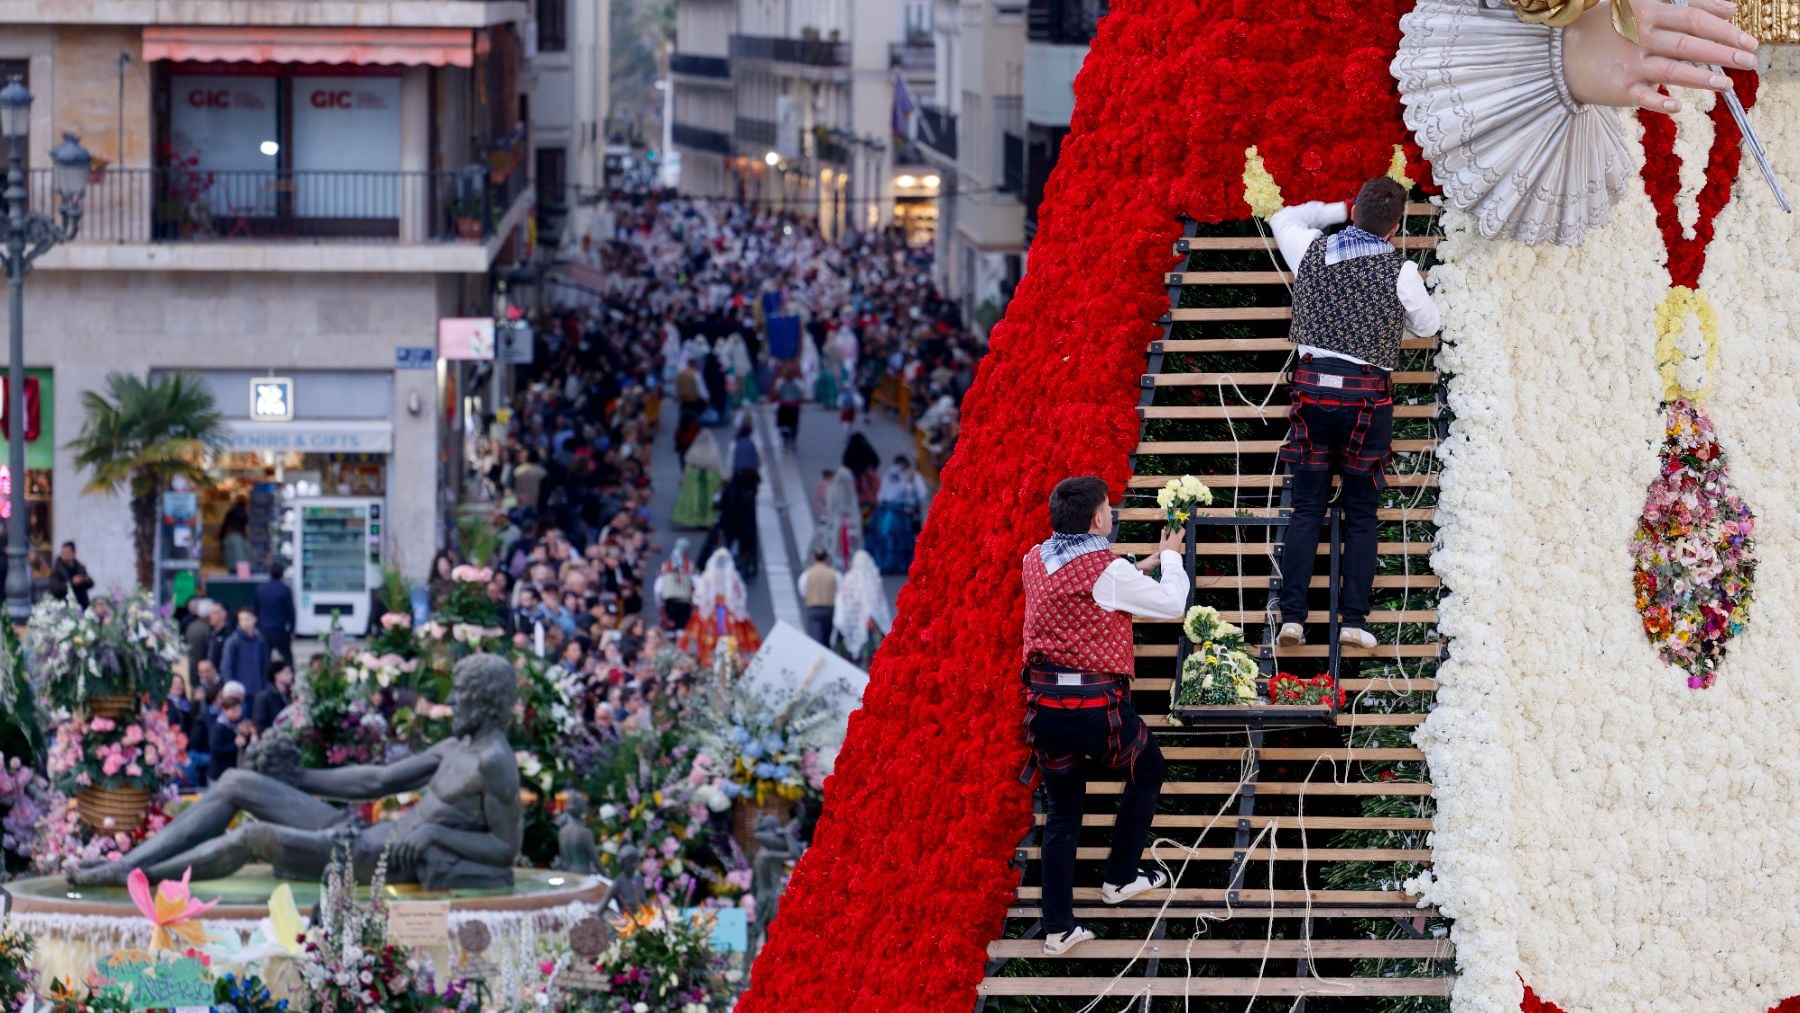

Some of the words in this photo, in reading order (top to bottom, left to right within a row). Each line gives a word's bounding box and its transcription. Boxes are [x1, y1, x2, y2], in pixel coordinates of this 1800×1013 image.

[188, 90, 230, 109] GIC
[310, 90, 353, 109] GIC
[295, 433, 305, 447] &
[310, 433, 361, 447] GIFTS
